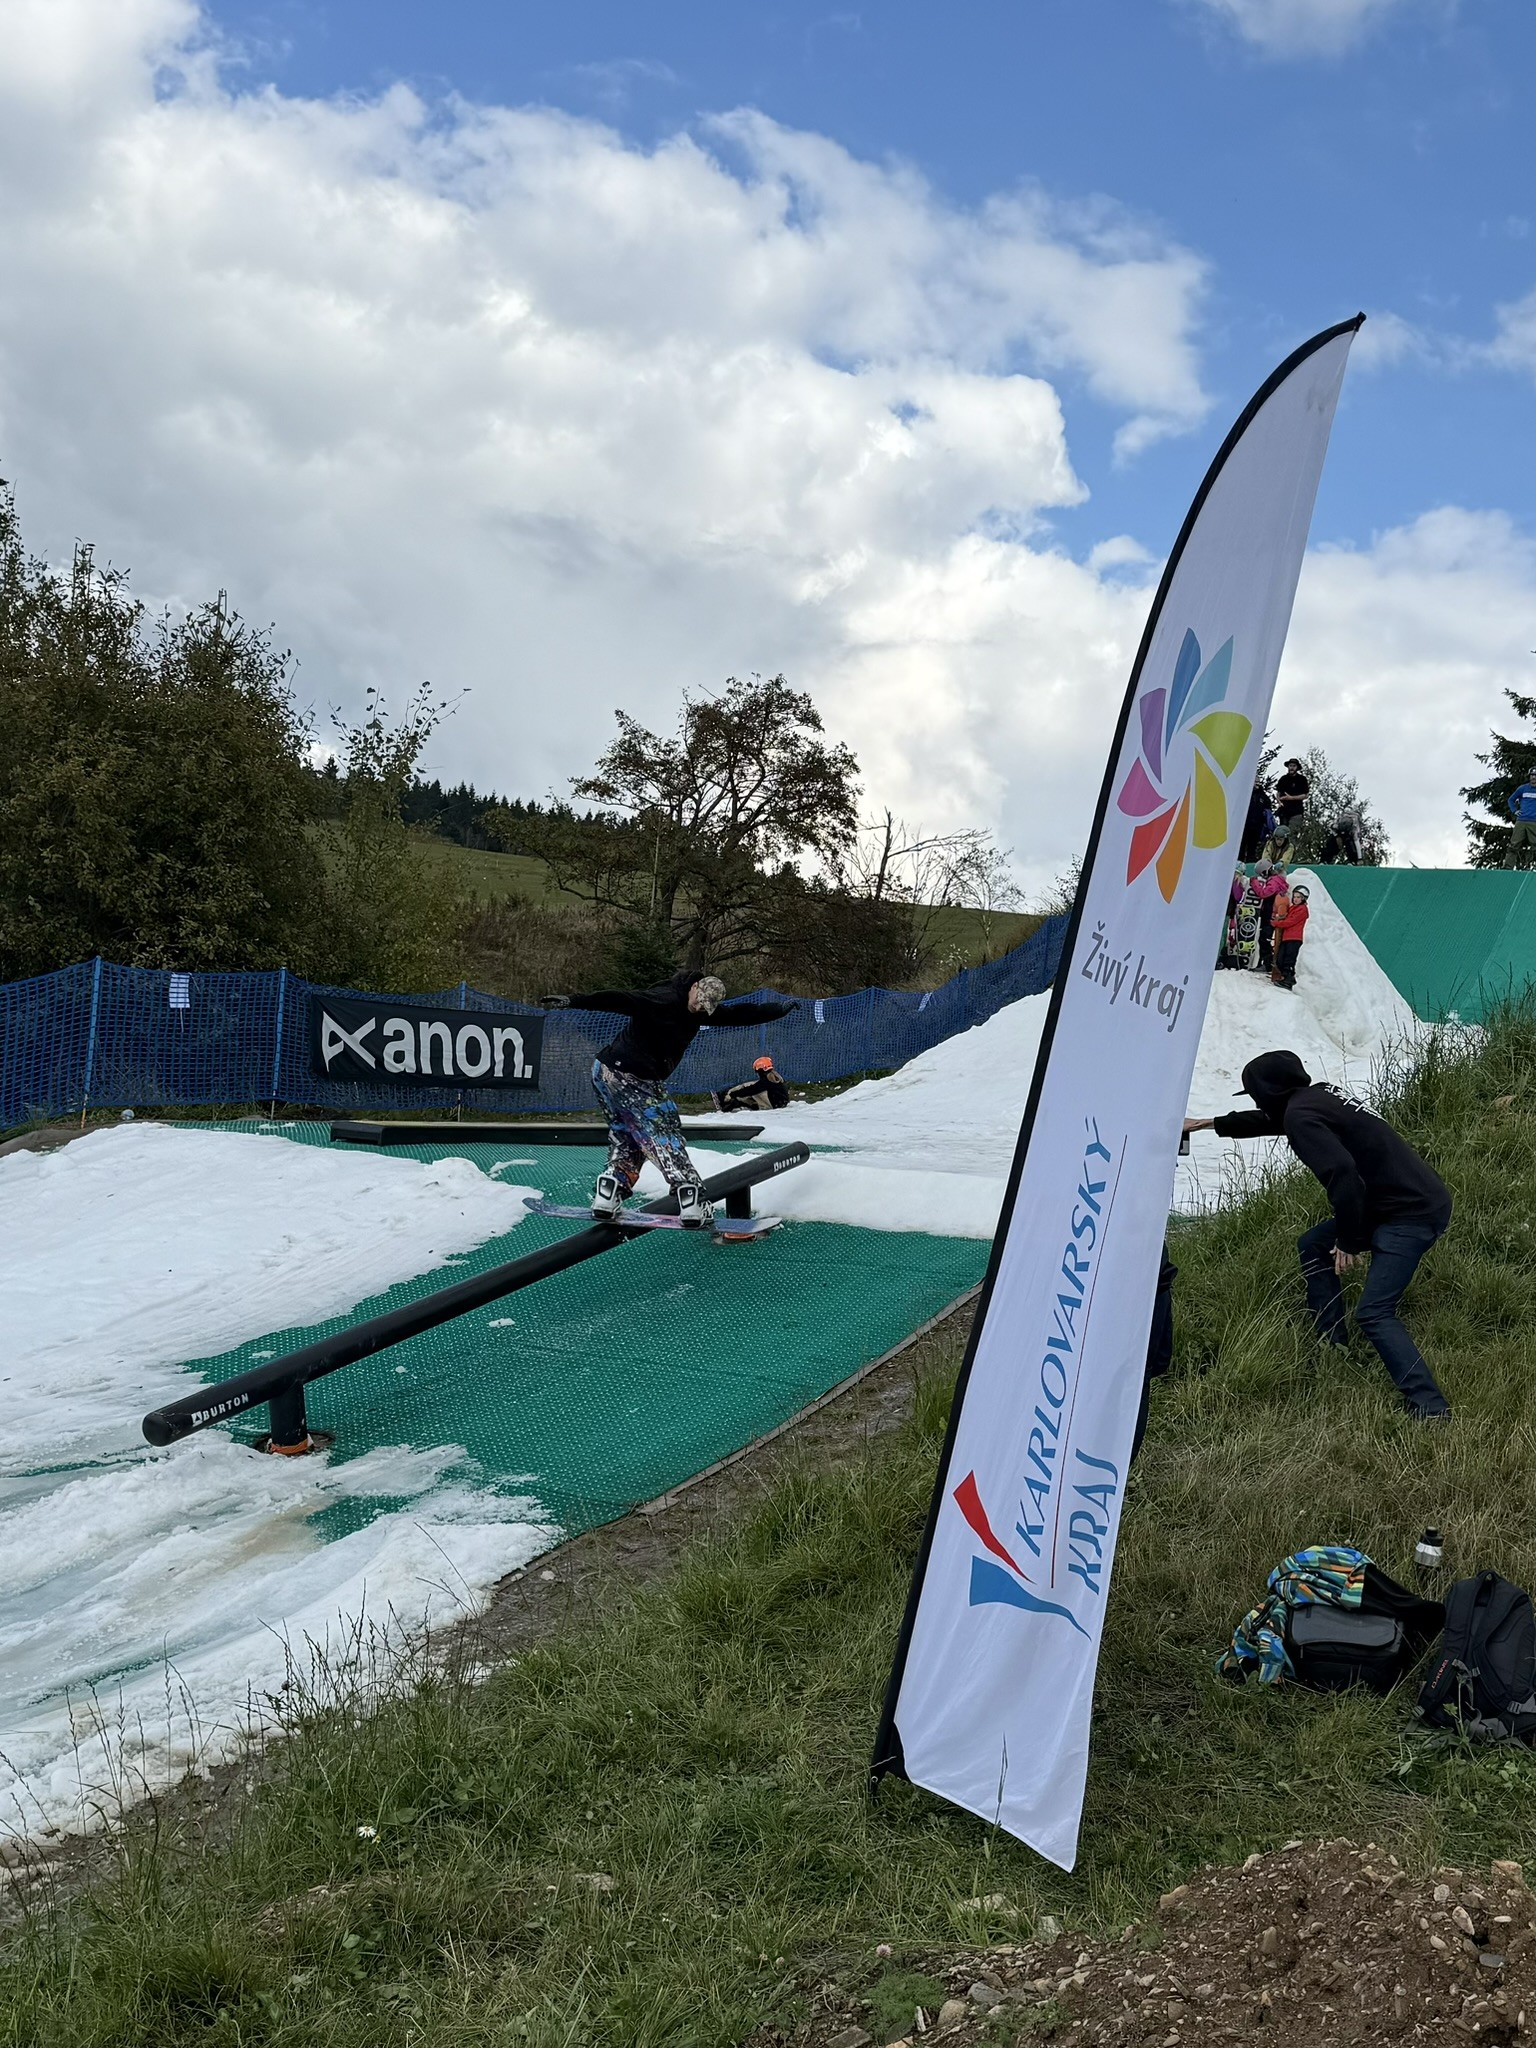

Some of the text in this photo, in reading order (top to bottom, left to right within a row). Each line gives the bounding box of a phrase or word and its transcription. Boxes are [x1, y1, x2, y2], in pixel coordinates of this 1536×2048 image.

[1081, 920, 1189, 1033] Živý kraj
[1015, 1115, 1111, 1558] KARLOVARSKÝ
[202, 1393, 249, 1421] BURTON
[1067, 1448, 1118, 1595] KRAJ
